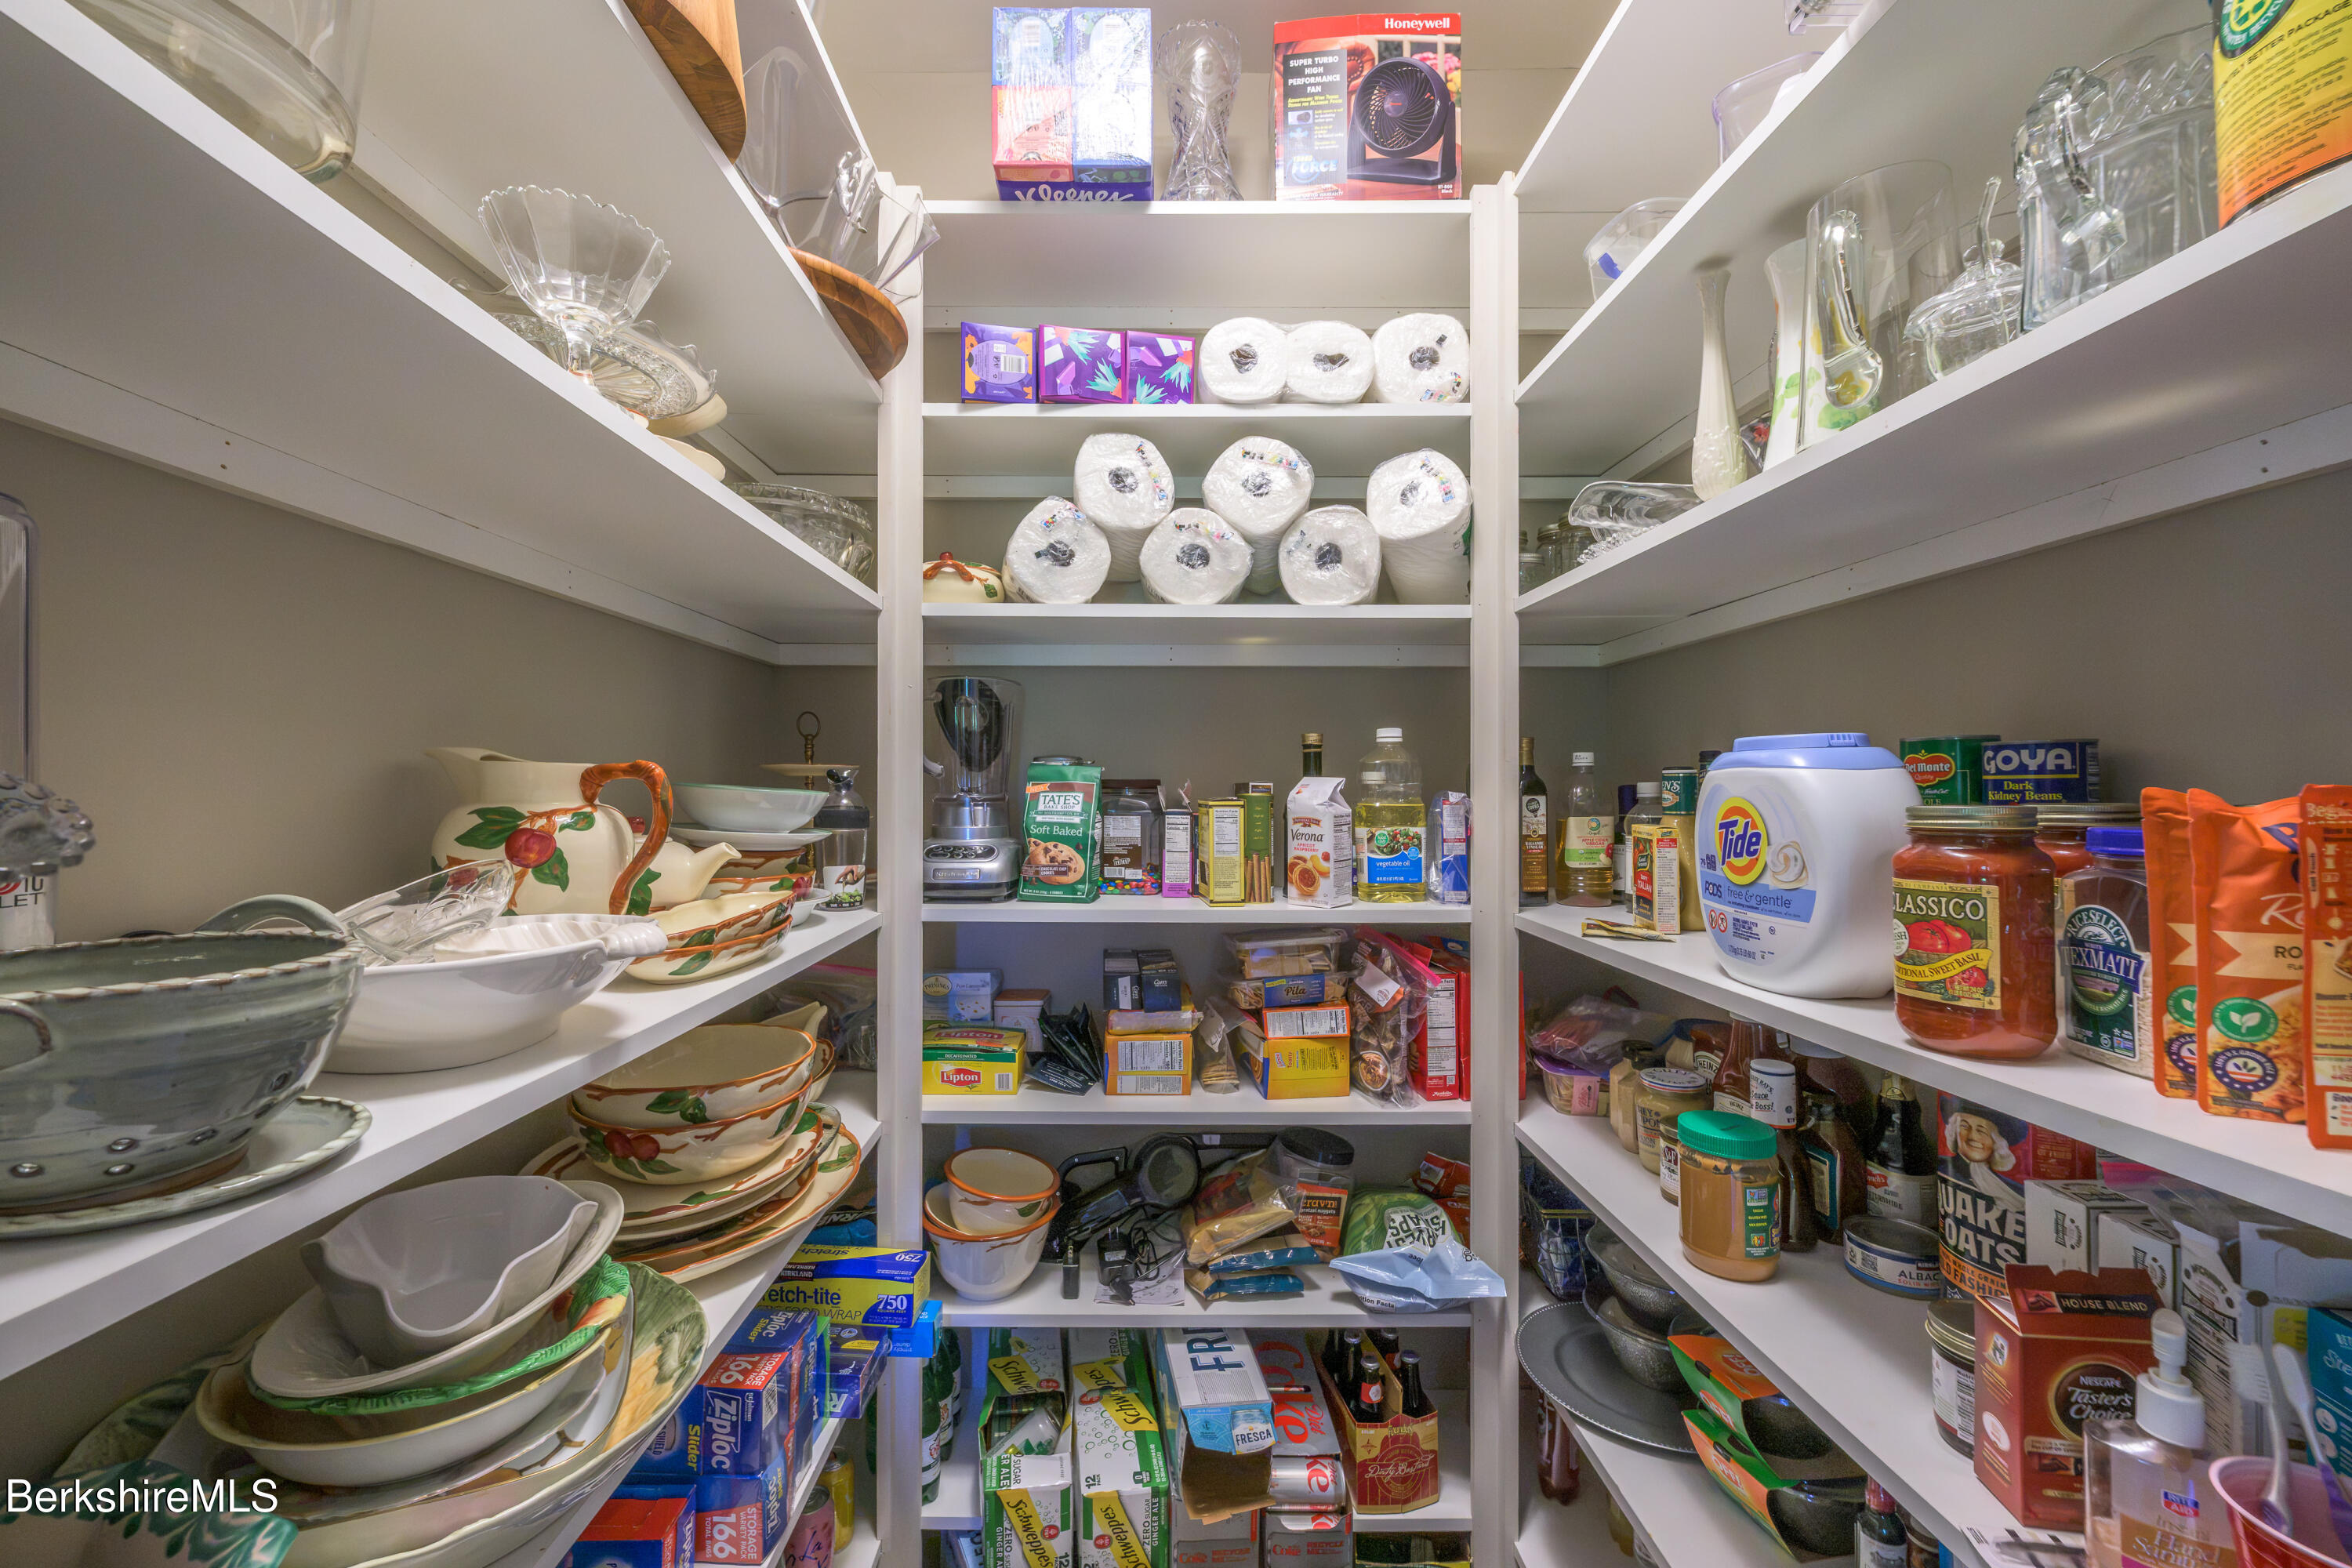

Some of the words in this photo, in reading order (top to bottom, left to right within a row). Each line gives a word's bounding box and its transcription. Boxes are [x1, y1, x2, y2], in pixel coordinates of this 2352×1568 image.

[1385, 17, 1450, 31] Honeywell
[1290, 58, 1312, 67] SUPER
[1314, 56, 1339, 64] TURBO
[1305, 67, 1323, 75] HIGH
[1288, 74, 1341, 86] PERFORMANCE
[1918, 763, 1951, 771] Monte
[1984, 748, 2073, 774] GOYA
[1661, 780, 1680, 793] EN'S
[2004, 782, 2032, 790] Dark
[1042, 795, 1080, 805] TATE'S
[1988, 791, 2021, 802] Kidney
[2025, 791, 2063, 800] Beans
[1030, 825, 1050, 834] Soft
[1052, 825, 1083, 837] Baked
[1290, 829, 1324, 842] Verona
[1718, 818, 1762, 866] Tide
[1637, 880, 1652, 893] ITALIAN
[1704, 880, 1722, 898] PODS
[1728, 887, 1744, 899] free
[1755, 893, 1791, 909] gentle
[2067, 909, 2127, 946] RICESELECT
[1929, 964, 1955, 978] SWEET
[1956, 953, 1984, 967] BASIL
[2060, 946, 2138, 980] TEXMATI
[1284, 985, 1307, 996] Pita
[1697, 1061, 1718, 1073] HEINZ
[943, 1071, 978, 1083] Lipton
[1751, 1090, 1769, 1099] Sauce
[1730, 1102, 1744, 1111] HEINZ
[1755, 1102, 1774, 1110] Boss!
[1302, 1197, 1337, 1208] crav'n
[1389, 1214, 1440, 1237] SNAPS
[1944, 1217, 2020, 1273] OATS
[895, 1254, 923, 1262] 750
[1898, 1269, 1940, 1282] ALBAC
[1952, 1259, 1976, 1277] WHOLE
[1977, 1271, 2006, 1289] GRAIN
[1953, 1270, 2009, 1297] FASHIO
[763, 1287, 841, 1306] etch-tite
[877, 1294, 908, 1310] 750
[1359, 1295, 1375, 1305] ition
[1376, 1299, 1395, 1308] Facts
[2060, 1298, 2103, 1310] HOUSE
[2107, 1301, 2148, 1312] BLEND
[822, 1309, 862, 1320] WRAP
[749, 1318, 770, 1342] Slider
[763, 1311, 794, 1338] Ziploc
[720, 1356, 760, 1385] 166
[752, 1354, 782, 1386] STORAGE
[993, 1360, 1038, 1394] Schwe
[744, 1371, 757, 1386] PACK
[2068, 1386, 2133, 1406] Taster's
[1305, 1404, 1326, 1436] Diet
[706, 1397, 738, 1469] Ziploc
[1236, 1428, 1273, 1446] FRESCA
[687, 1424, 701, 1471] Slider
[1000, 1468, 1010, 1486] ALE
[1012, 1459, 1021, 1485] SUGAR
[1305, 1457, 1330, 1493] ke
[1365, 1463, 1396, 1482] Dirty
[1085, 1474, 1096, 1489] 12
[712, 1513, 736, 1559] 166
[747, 1507, 757, 1560] STORAGE
[1007, 1499, 1054, 1568] Schweppes
[1179, 1552, 1207, 1563] Coke
[1272, 1544, 1301, 1557] Coke
[1059, 1552, 1069, 1567] 12
